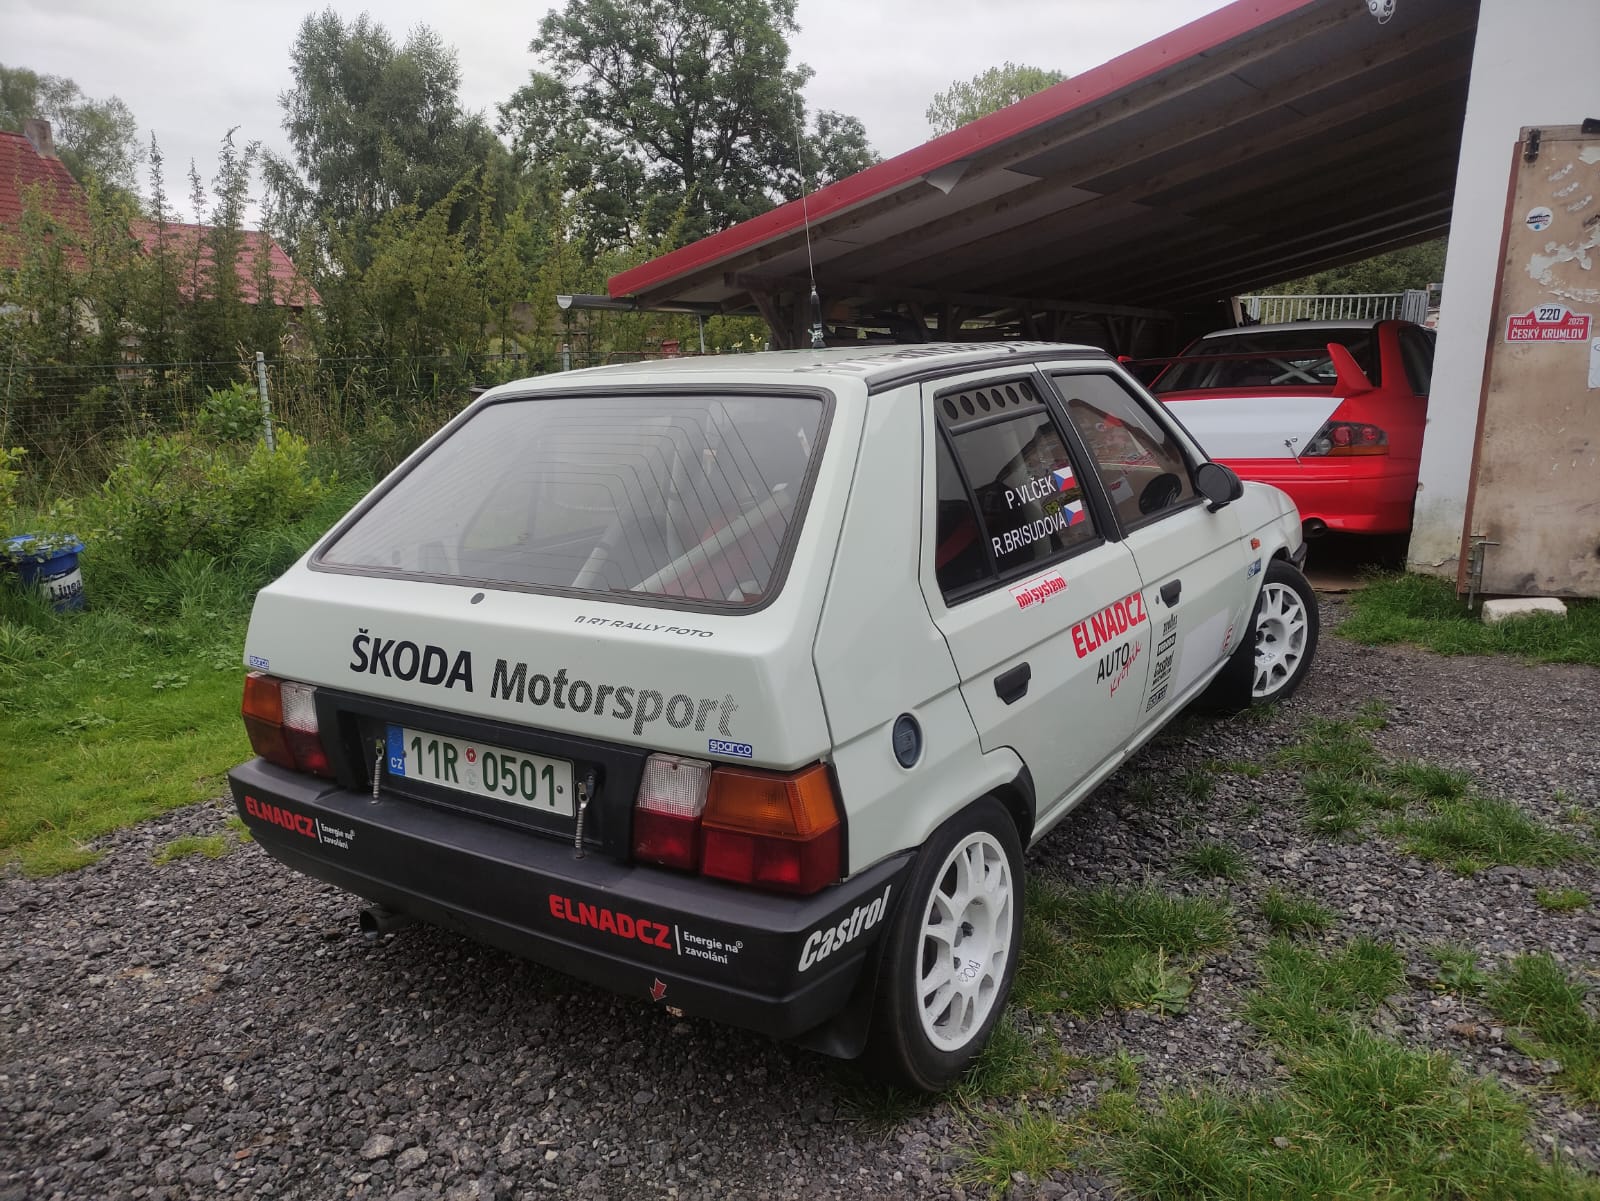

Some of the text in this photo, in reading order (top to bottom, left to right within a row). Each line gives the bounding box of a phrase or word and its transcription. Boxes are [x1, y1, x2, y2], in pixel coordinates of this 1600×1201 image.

[1539, 308, 1561, 321] 220
[1511, 326, 1584, 339] ČESKÝ KRUMLOV
[587, 617, 714, 638] RT RALLY FOTO
[1072, 592, 1147, 659] ELNADCZ
[1096, 642, 1130, 684] AUTO
[350, 628, 739, 736] ŠKODA Motorsport
[710, 740, 752, 756] sparco
[390, 757, 404, 770] CZ
[411, 736, 555, 807] 11R 0501
[245, 796, 316, 838] ELNADCZ
[321, 823, 344, 838] Energie
[549, 894, 672, 950] ELNADCZ
[798, 884, 892, 972] Castrol
[683, 931, 723, 949] Energie
[684, 946, 729, 965] zavolání
